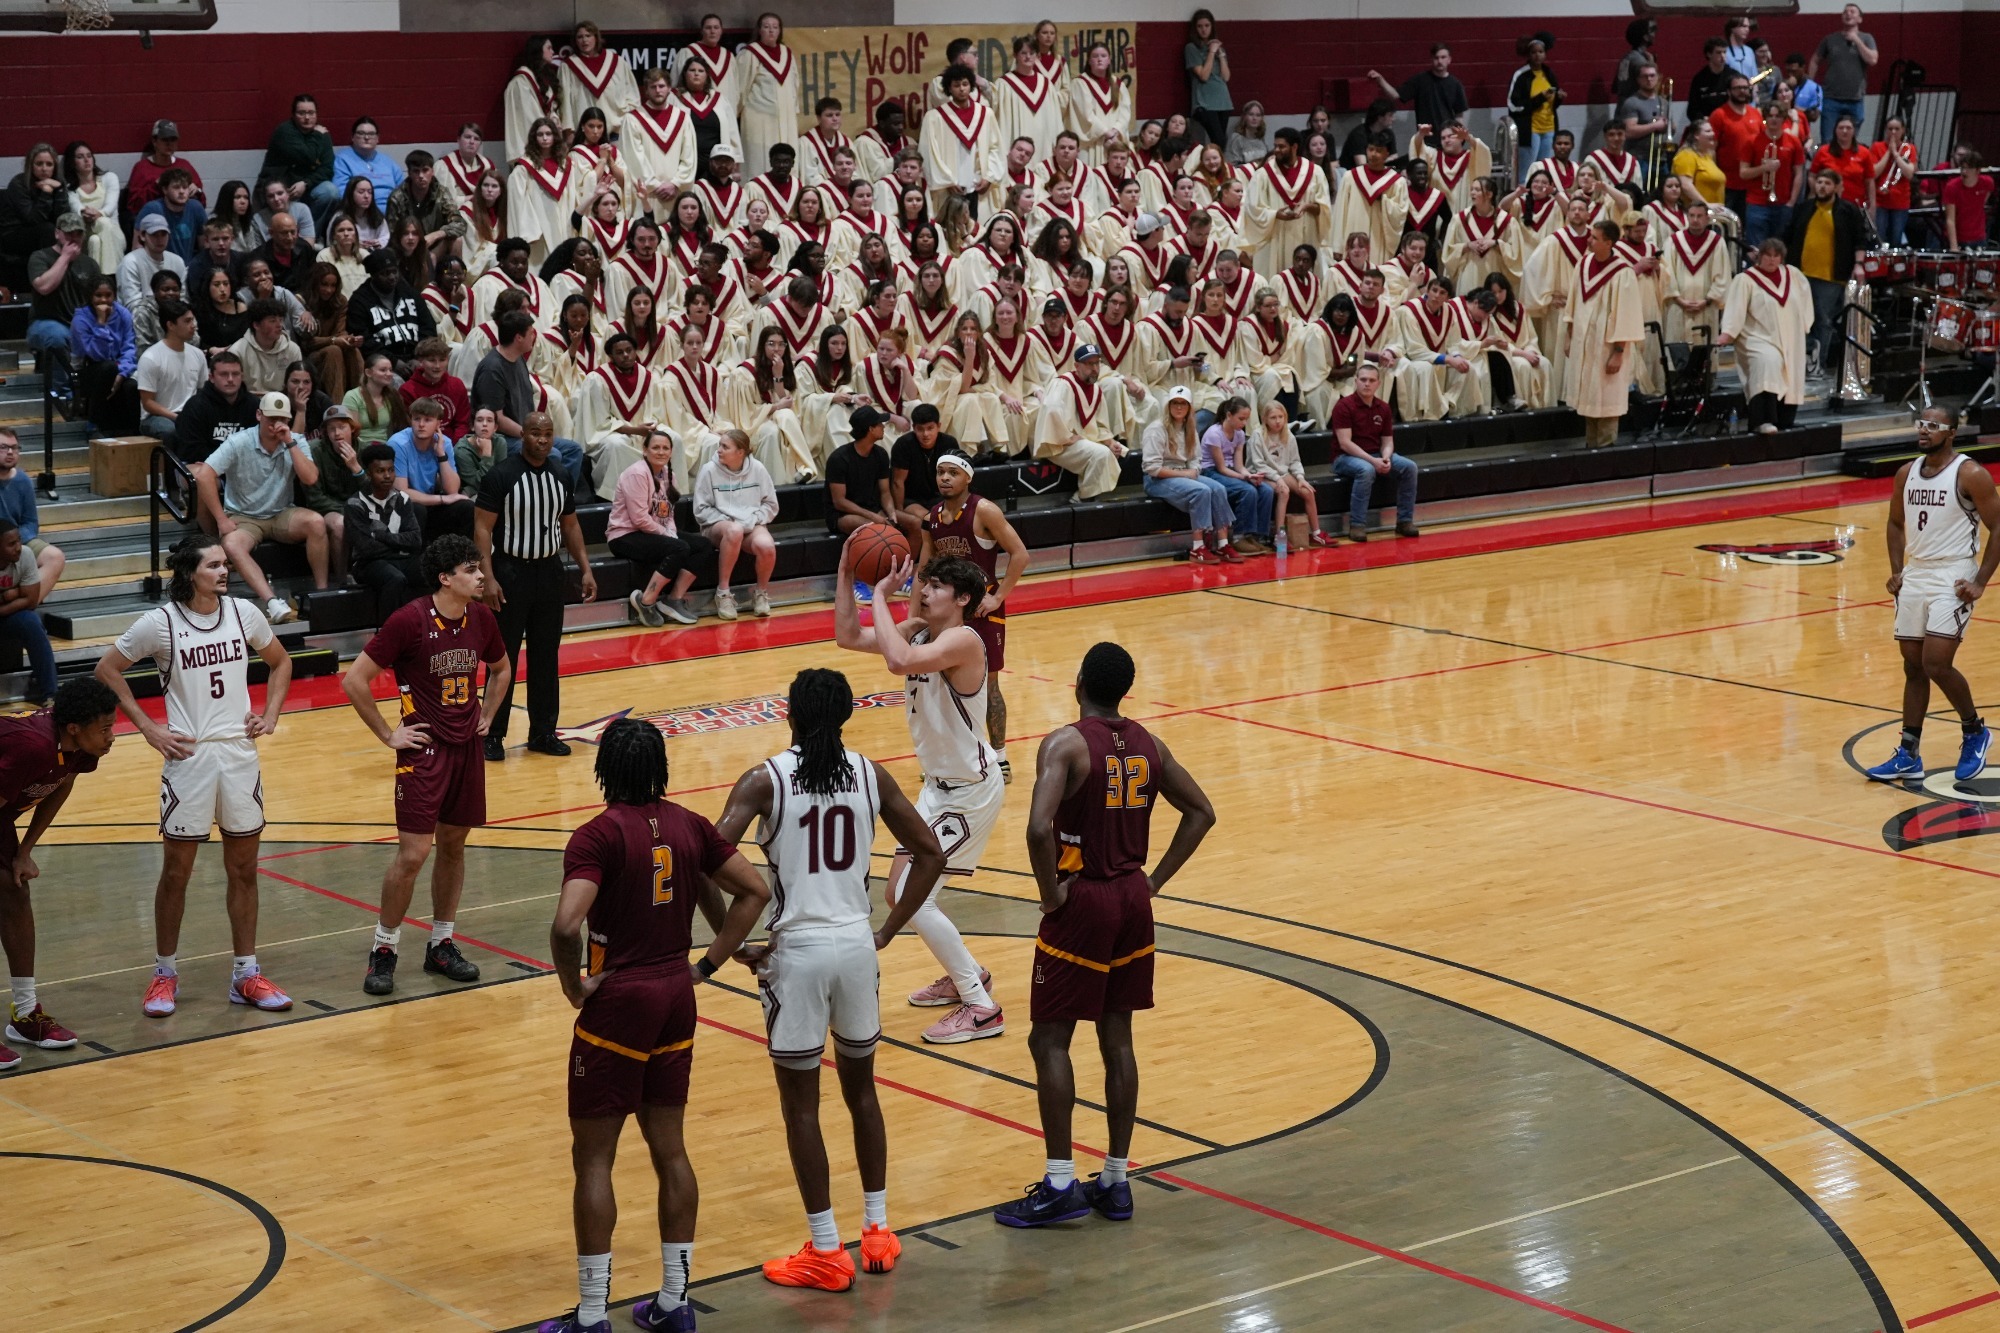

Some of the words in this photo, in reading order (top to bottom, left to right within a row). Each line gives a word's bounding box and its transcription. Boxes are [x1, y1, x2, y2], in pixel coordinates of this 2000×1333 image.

[620, 47, 649, 70] AM
[656, 47, 678, 70] FA
[864, 31, 928, 76] Wolf
[801, 48, 861, 115] HEY
[1907, 488, 1947, 506] MOBILE
[1918, 510, 1928, 531] 8
[180, 638, 243, 670] MOBILE
[430, 648, 478, 674] LOYOLA
[209, 670, 225, 699] 5
[441, 675, 469, 706] 23
[1112, 732, 1126, 751] L
[1105, 755, 1150, 809] 32
[799, 804, 856, 875] 10
[651, 845, 673, 906] 2
[1034, 964, 1045, 984] L
[574, 1055, 585, 1077] L
